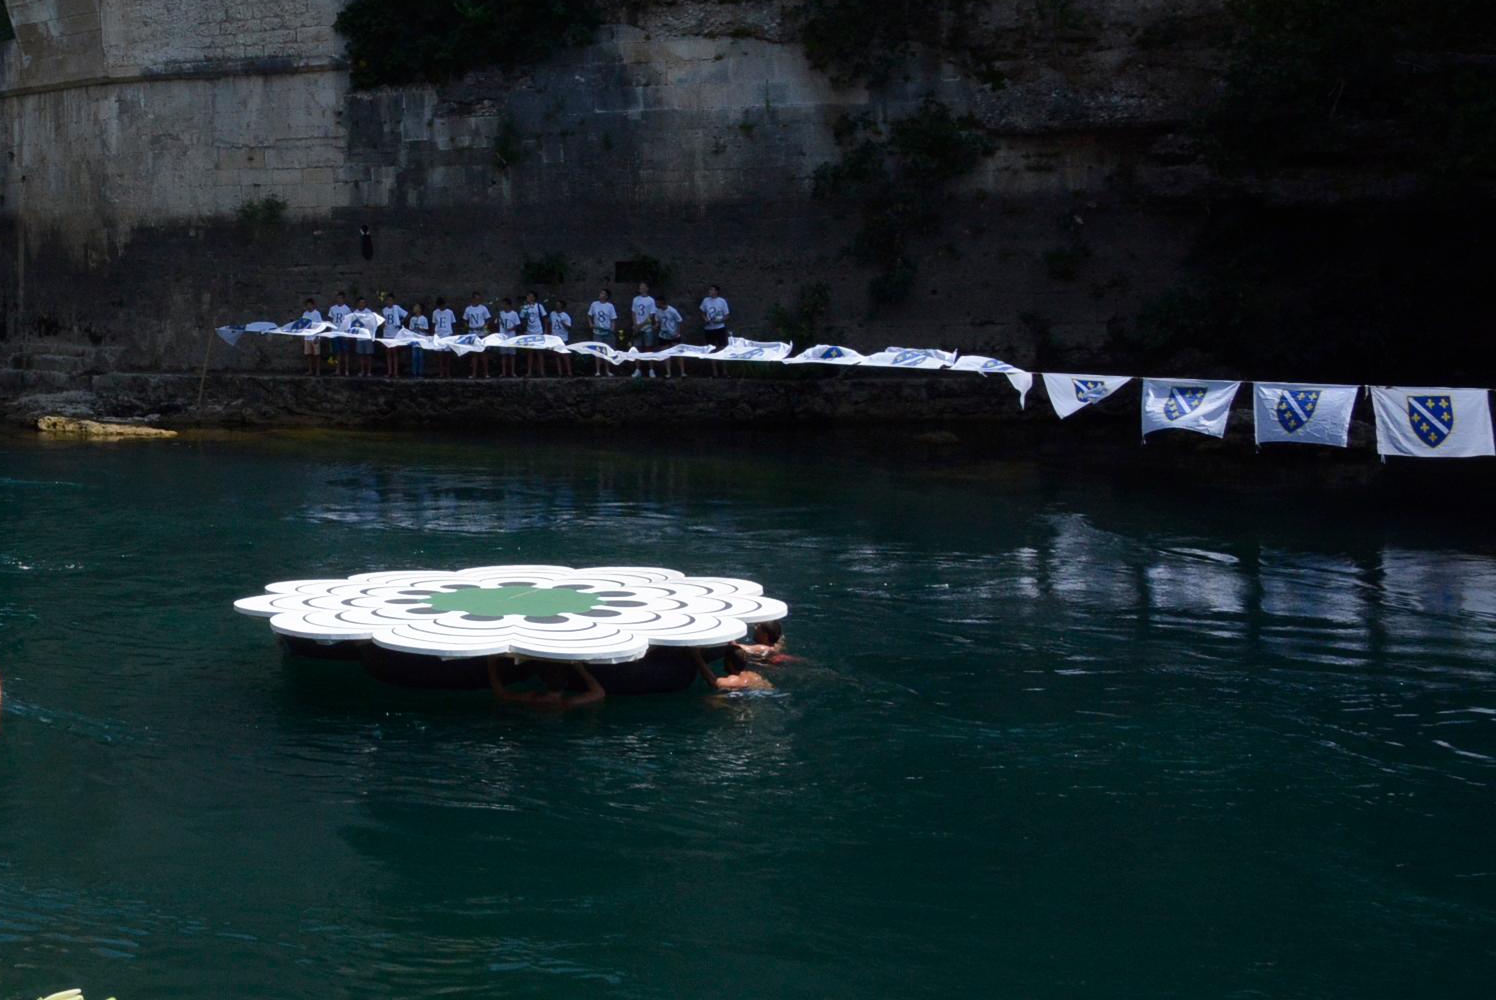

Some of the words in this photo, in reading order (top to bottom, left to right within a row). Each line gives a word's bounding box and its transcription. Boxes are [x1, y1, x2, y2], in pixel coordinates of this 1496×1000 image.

[638, 303, 646, 316] 3
[336, 312, 343, 323] R
[440, 316, 447, 328] E
[470, 313, 480, 324] N
[598, 311, 606, 323] 8
